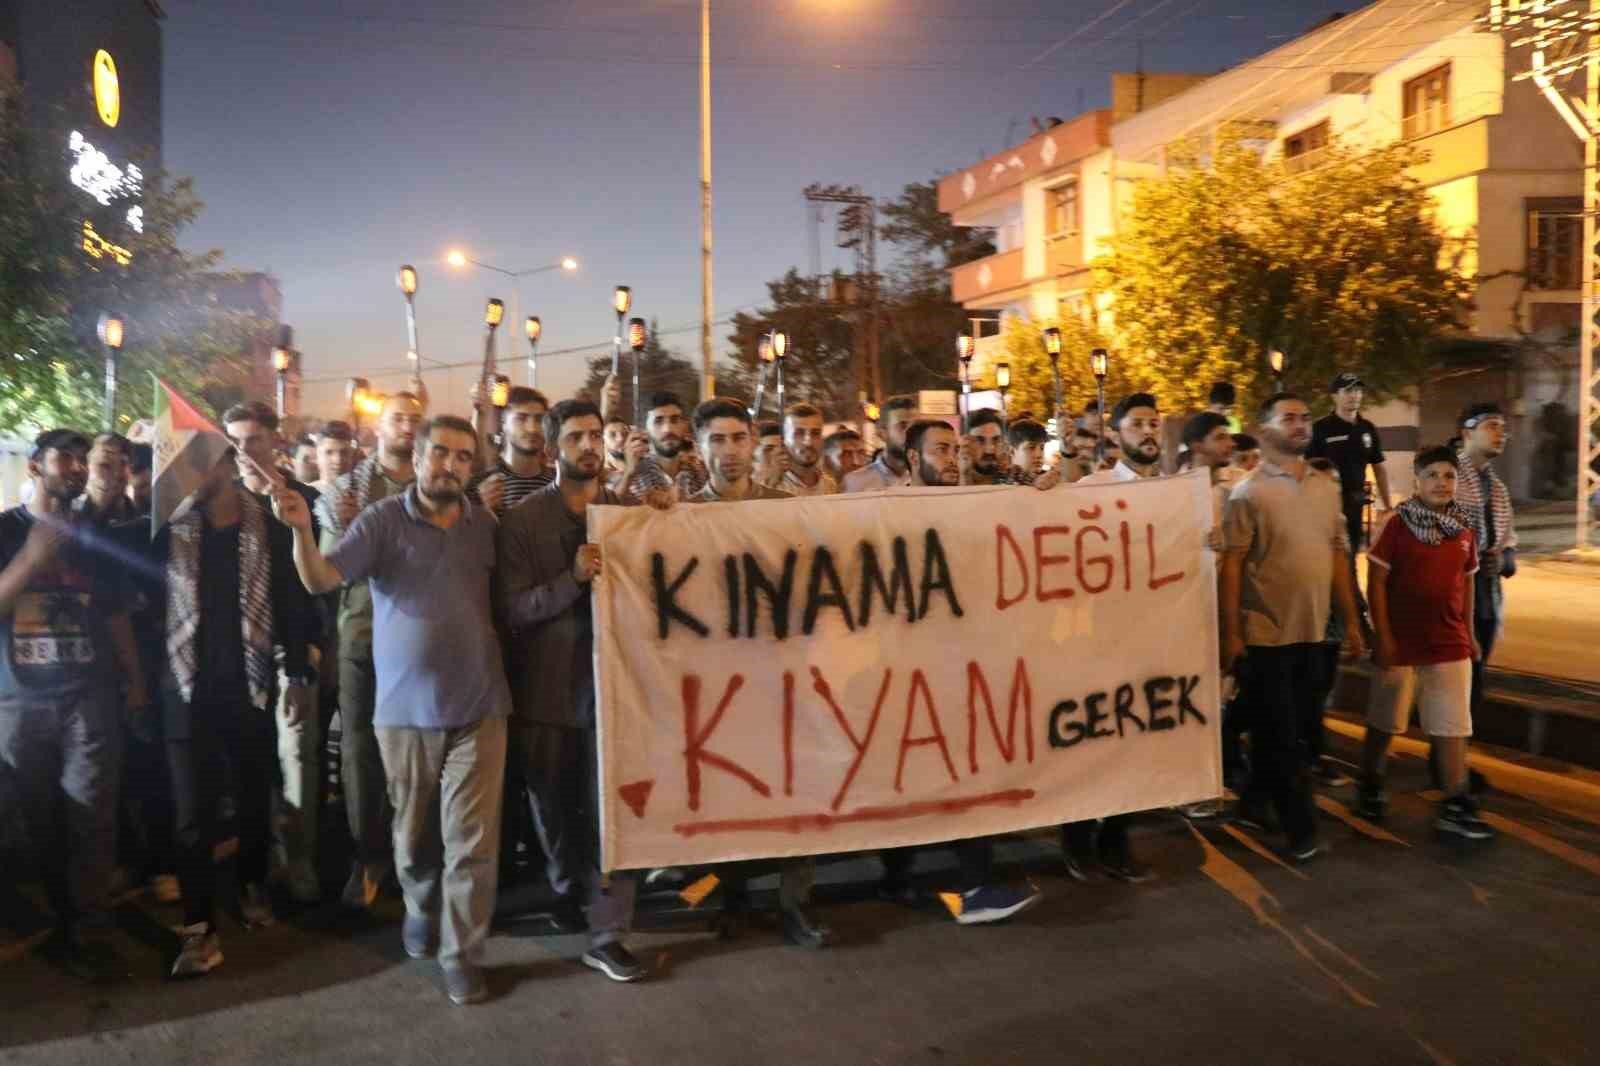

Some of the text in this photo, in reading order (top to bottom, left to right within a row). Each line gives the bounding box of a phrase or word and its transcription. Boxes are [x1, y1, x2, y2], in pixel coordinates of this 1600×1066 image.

[651, 500, 1185, 641] KINAMA DEĞİL
[682, 657, 1207, 811] KIYAM GEREK
